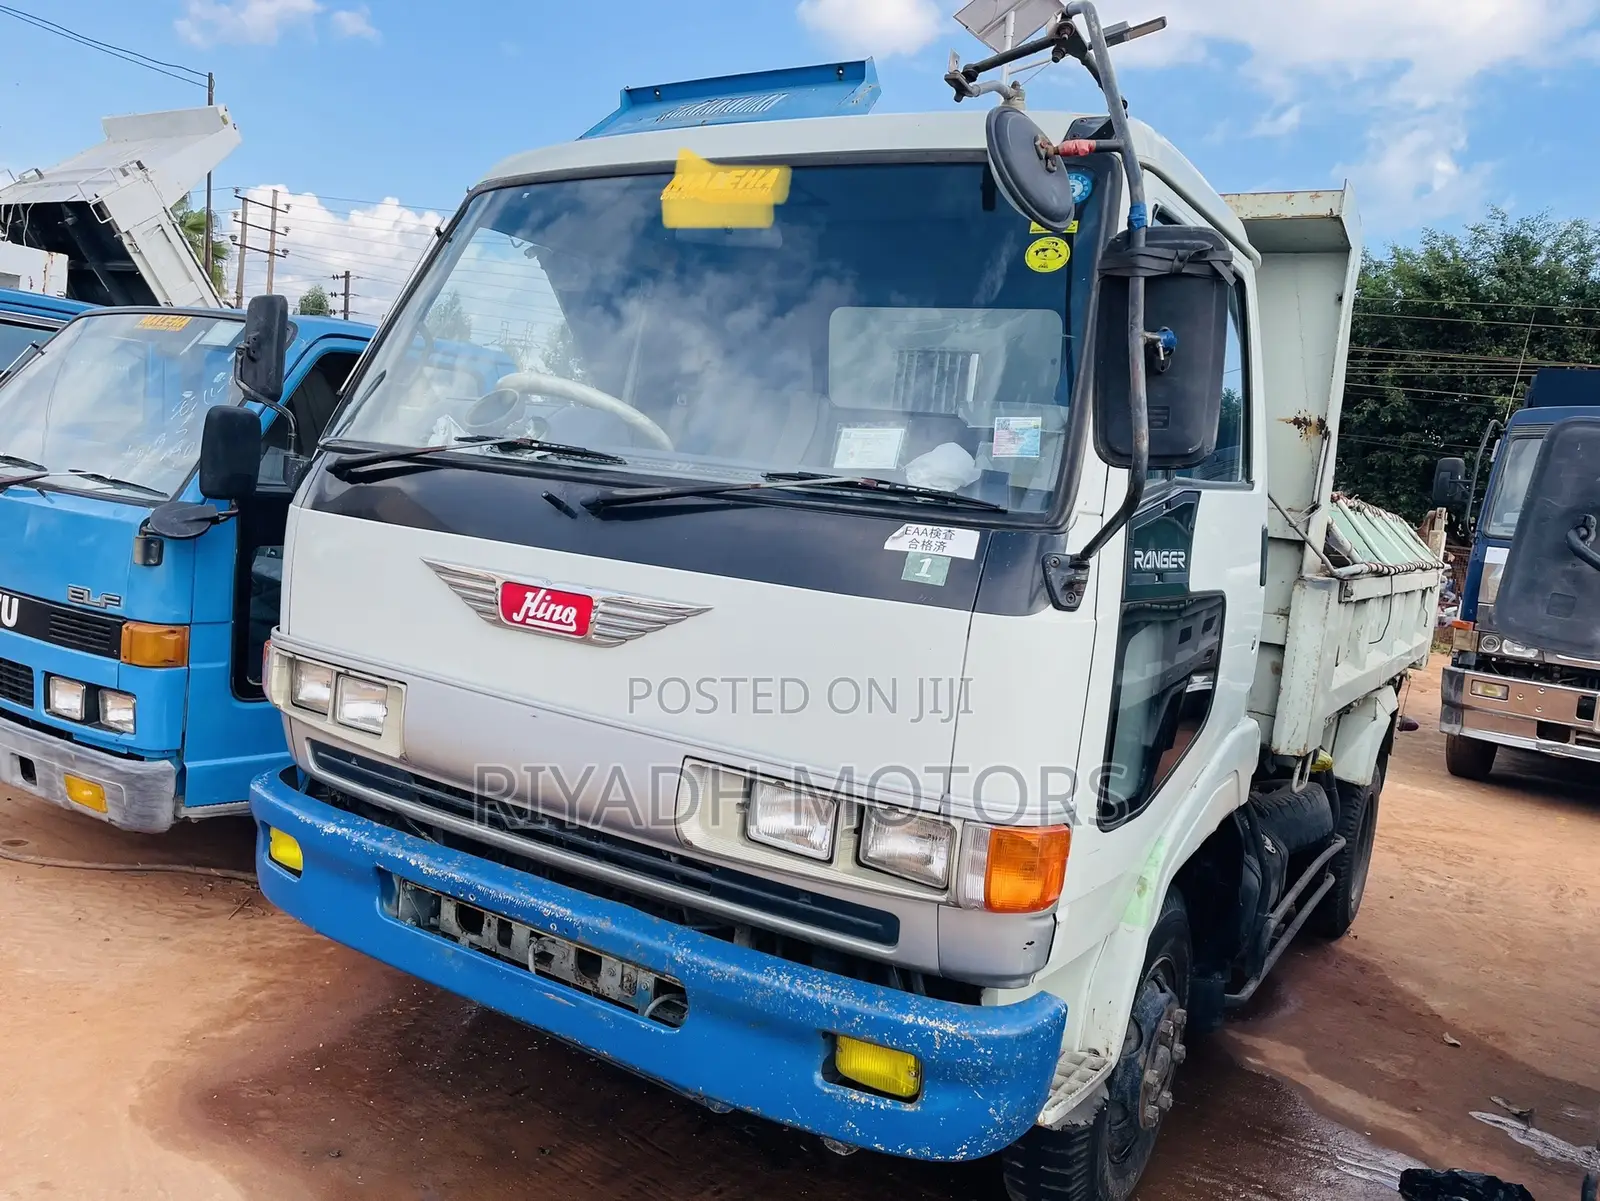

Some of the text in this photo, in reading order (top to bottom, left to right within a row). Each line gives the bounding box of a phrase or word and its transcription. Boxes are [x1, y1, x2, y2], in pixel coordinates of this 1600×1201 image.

[904, 525, 956, 541] EAA検査
[908, 537, 948, 553] 合格済
[915, 557, 932, 578] 1
[1133, 550, 1186, 570] RANGER
[67, 584, 122, 609] ELF
[0, 592, 19, 628] U
[512, 588, 577, 631] Hino
